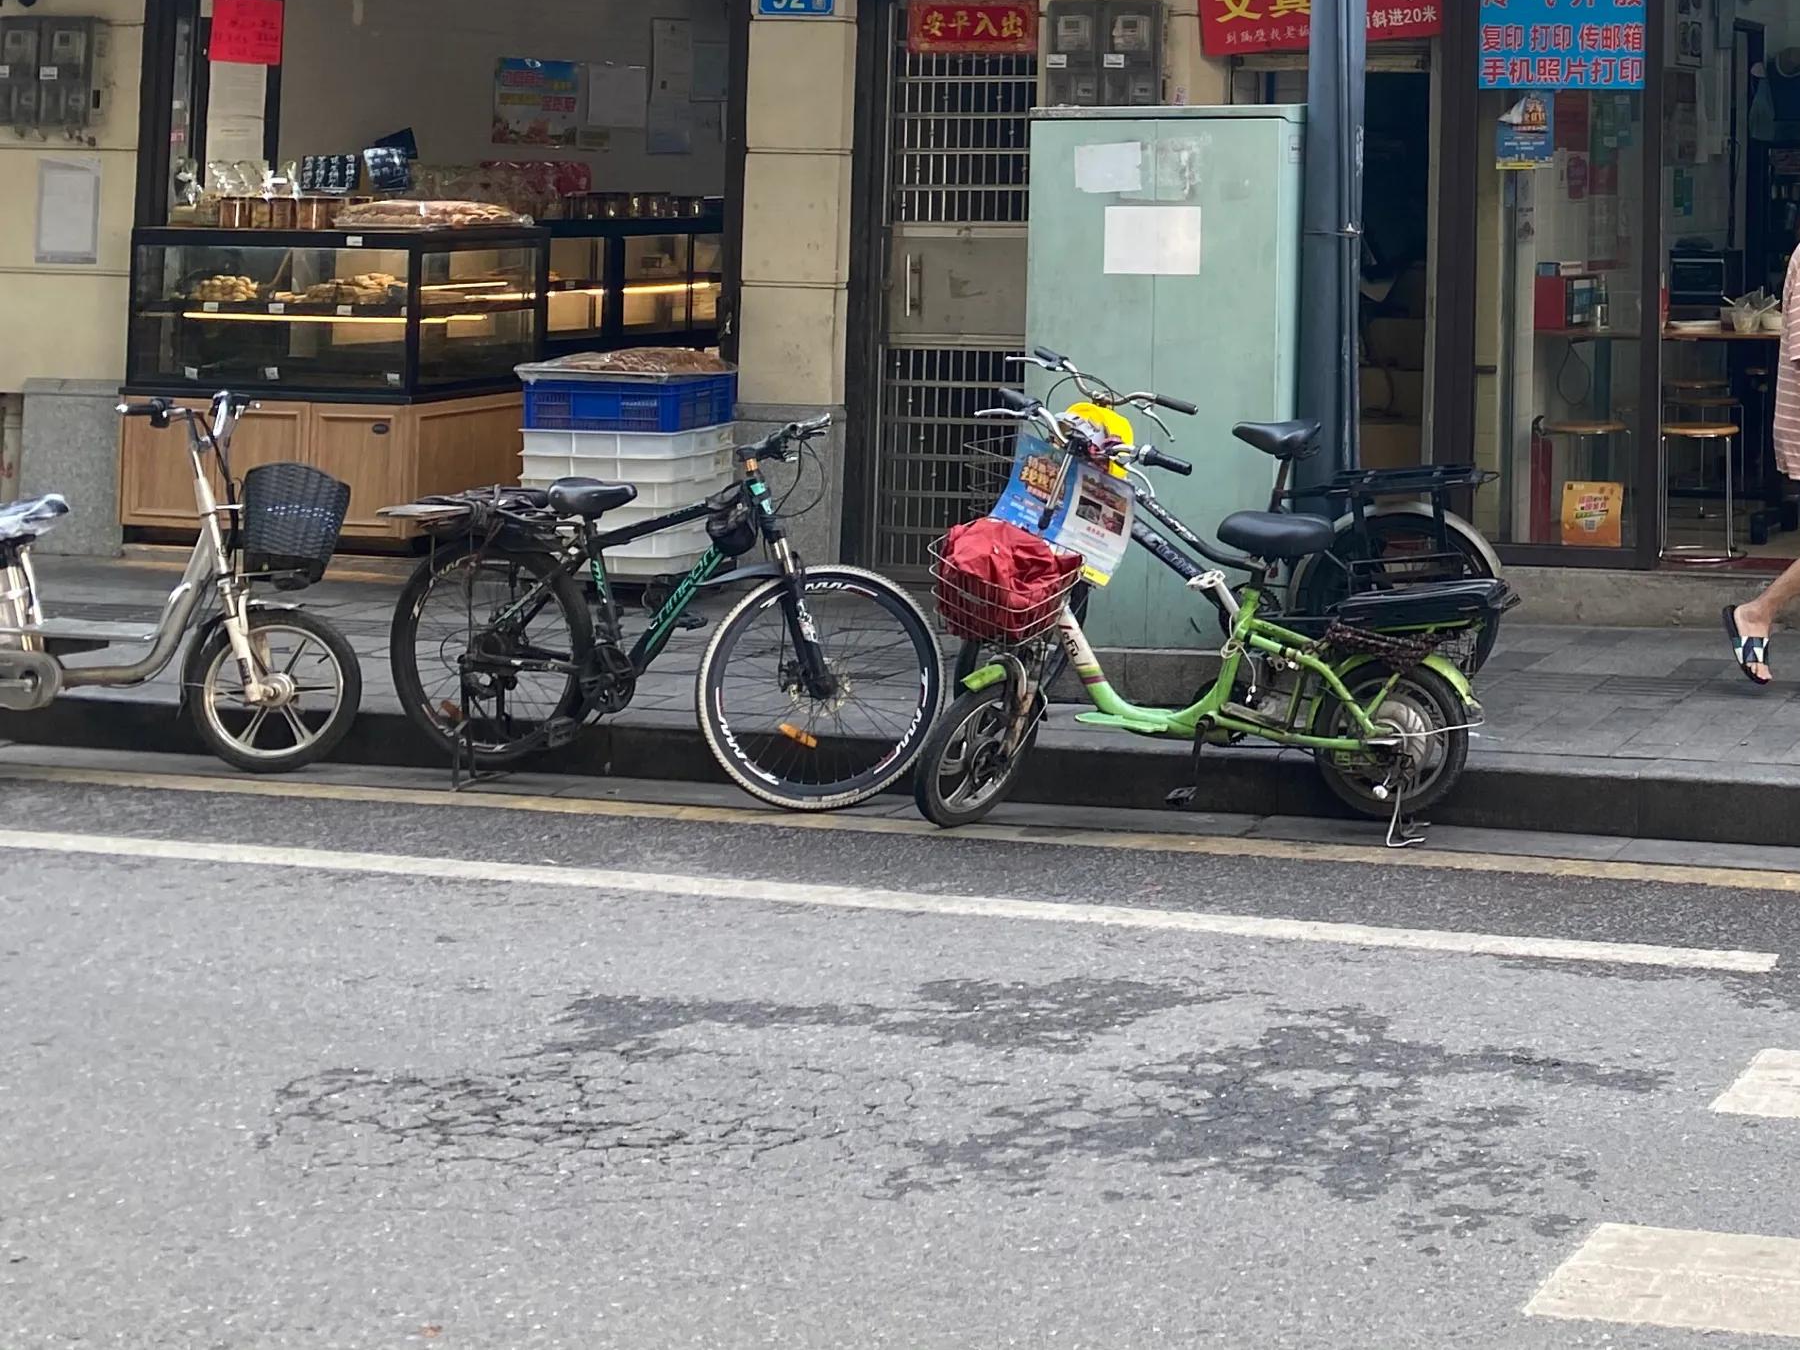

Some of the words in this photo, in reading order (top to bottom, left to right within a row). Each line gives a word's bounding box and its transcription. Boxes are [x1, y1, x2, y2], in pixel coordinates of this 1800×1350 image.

[1366, 5, 1437, 29] 斜进20米
[1482, 24, 1523, 52] 复印
[1529, 24, 1573, 52] 打印
[1578, 22, 1645, 52] 传邮箱
[1482, 58, 1644, 84] 手机照片打印
